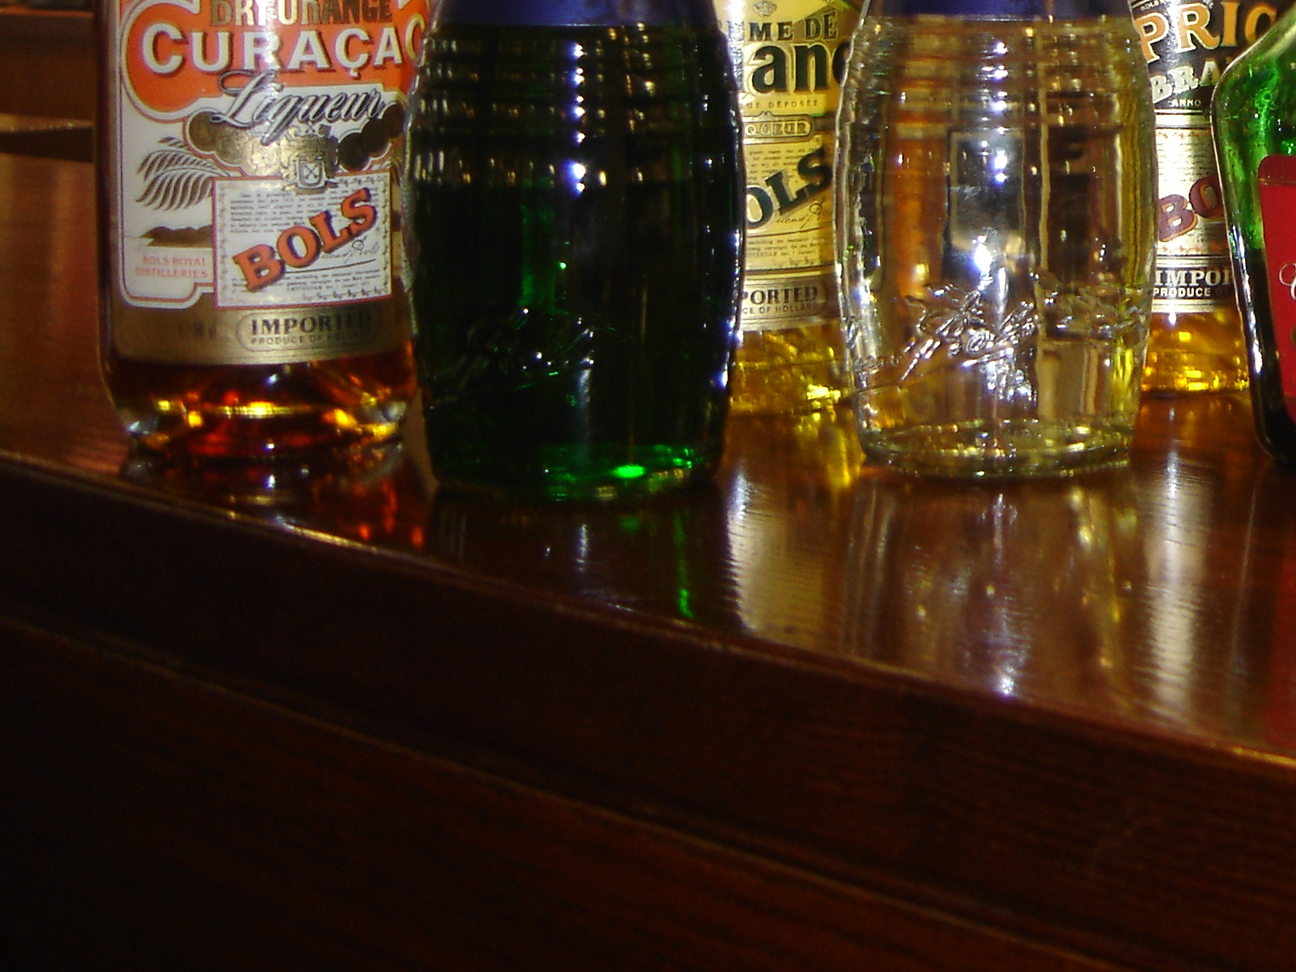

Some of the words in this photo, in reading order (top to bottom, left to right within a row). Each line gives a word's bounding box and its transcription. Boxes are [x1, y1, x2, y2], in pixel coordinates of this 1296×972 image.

[142, 16, 425, 81] CURAÇAO
[804, 9, 839, 42] DE
[209, 70, 386, 146] Liqueur
[232, 187, 378, 293] BOLS
[1153, 287, 1211, 298] PRODUCE
